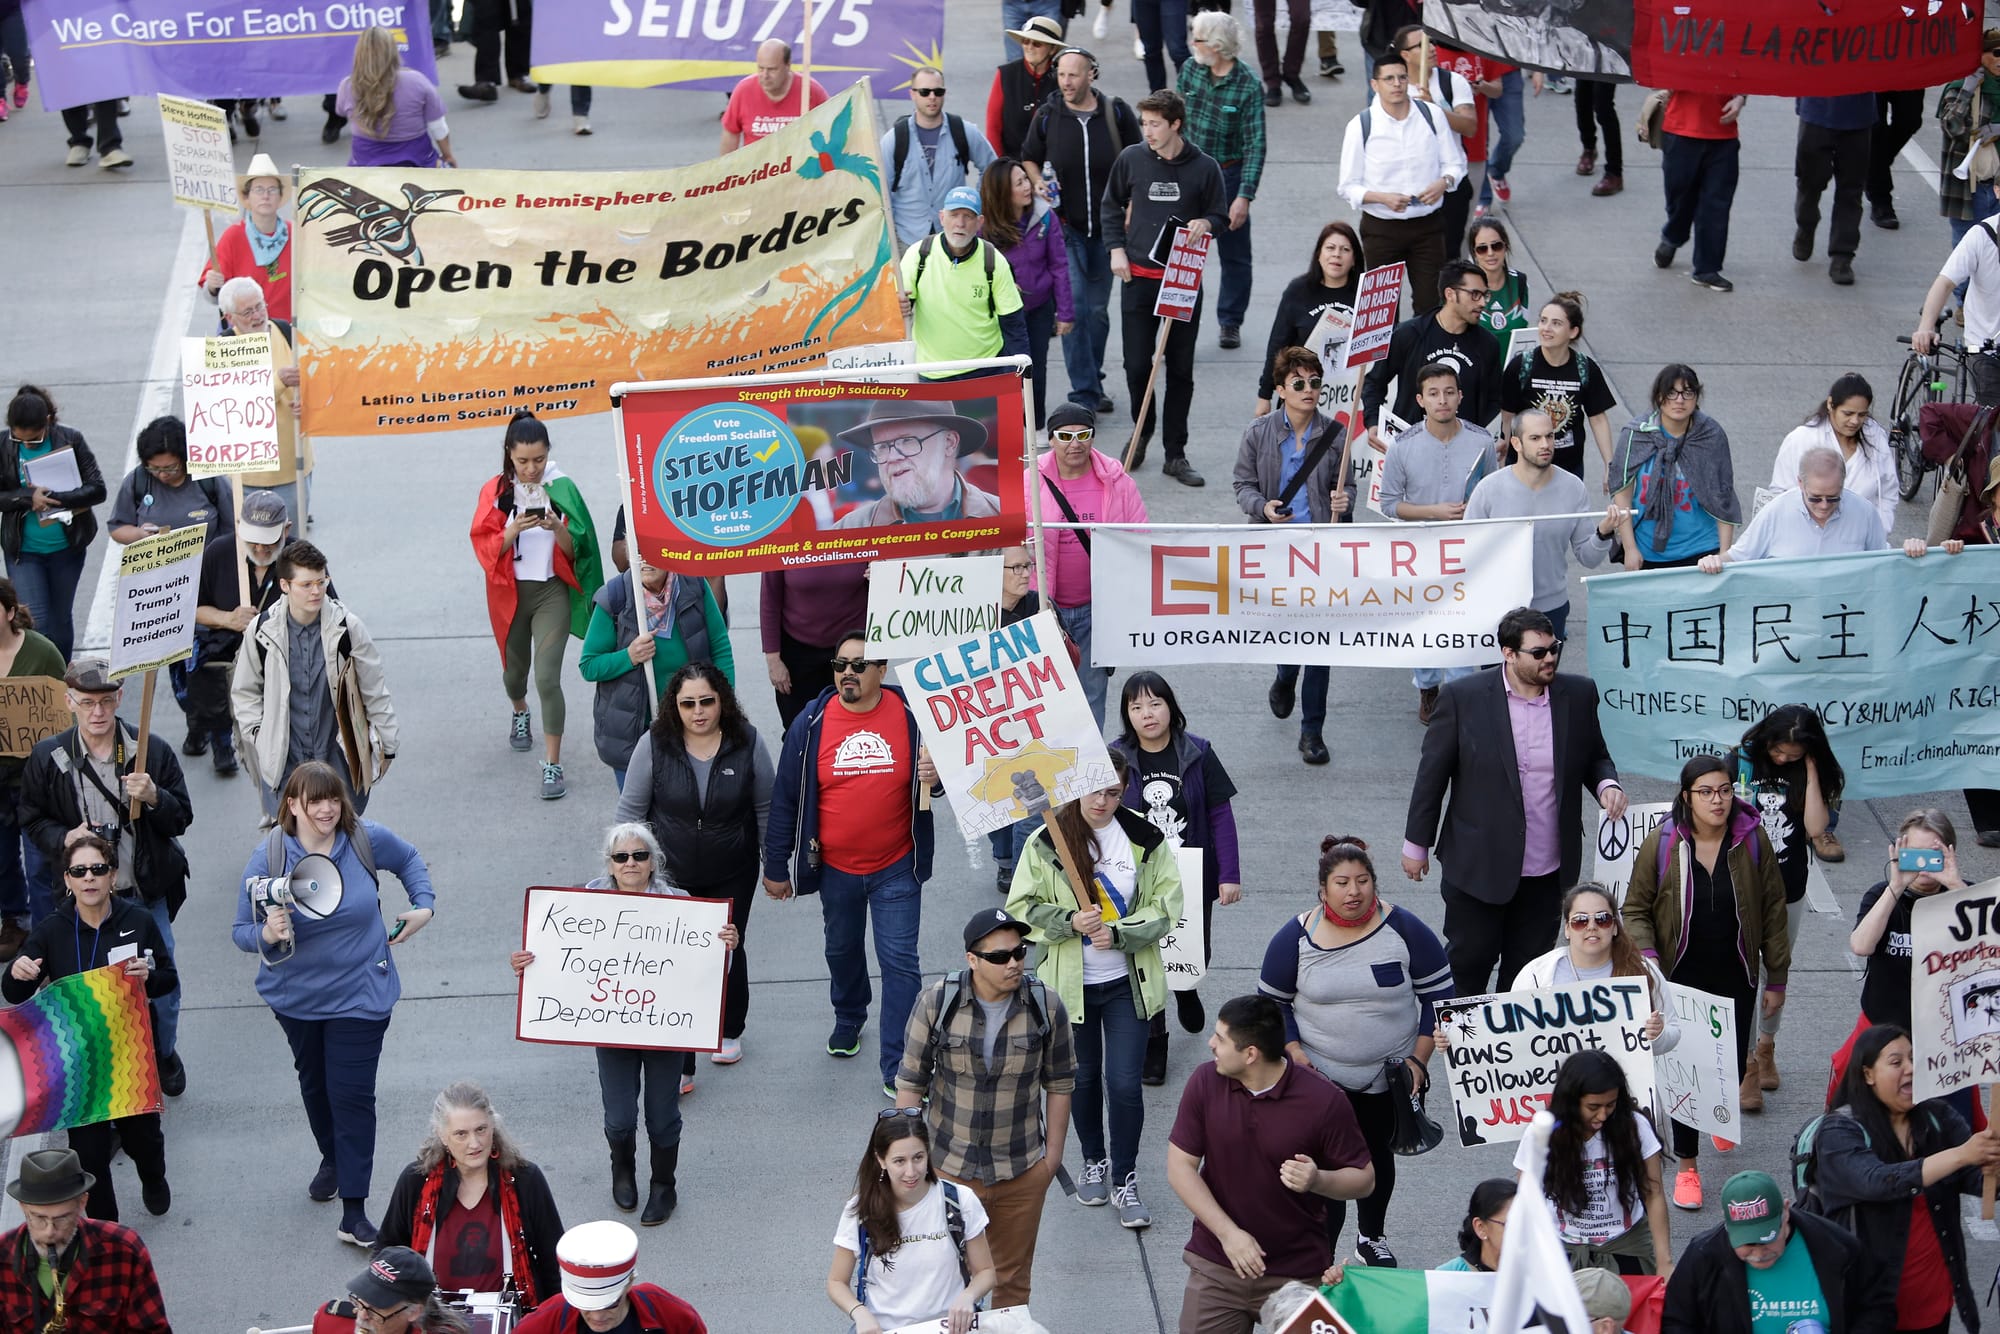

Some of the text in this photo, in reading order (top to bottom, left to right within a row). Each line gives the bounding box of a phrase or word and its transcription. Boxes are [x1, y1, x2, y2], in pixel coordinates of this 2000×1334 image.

[51, 2, 406, 42] We Care For Each Other
[603, 0, 873, 47] SEIU 775
[1660, 16, 1957, 66] VIVA LA REVOLUTION
[182, 126, 222, 147] STOP
[174, 175, 238, 205] FAMILIES
[458, 155, 793, 212] One hemisphere, undivided
[353, 198, 866, 309] Open the Borders
[1171, 250, 1205, 270] NO RAIDS
[1166, 267, 1197, 287] NO WAR
[1362, 269, 1400, 292] NO WALL
[1358, 293, 1370, 311] NO
[1371, 288, 1399, 308] RAIDS
[1354, 308, 1389, 332] NO WAR
[220, 345, 269, 358] Hoffman
[706, 335, 822, 369] Radical Women
[1350, 330, 1392, 352] RESIST TRUMP
[231, 359, 260, 368] Senate
[762, 351, 827, 373] Ixmucan
[183, 369, 272, 387] SOLIDARITY
[362, 378, 597, 407] Latino Liberation Movement
[738, 384, 910, 402] Strength through solidarity
[189, 396, 275, 434] ACROSS
[377, 398, 579, 427] Freedom Socialist Party
[713, 418, 741, 429] Vote
[678, 429, 777, 444] Freedom Socialist
[188, 440, 279, 463] BORDERS
[664, 443, 752, 482] STEVE
[671, 450, 855, 519] HOFFMAN
[710, 510, 753, 522] for U.S.
[713, 524, 751, 535] Senate
[1082, 512, 1095, 521] BE
[121, 535, 204, 567] Steve Hoffman
[128, 527, 200, 551] Freedom Socialist Party
[660, 525, 1001, 562] Send a union militant & antiwar veteran to Congress
[132, 552, 191, 574] For U.S. Senate
[781, 548, 879, 567] VoteSocialism.com
[1239, 538, 1466, 579] ENTRE
[128, 574, 190, 600] Down with
[899, 562, 964, 596] ¡Viva
[134, 592, 181, 612] Trump's
[1239, 581, 1466, 608] HERMANOS
[131, 609, 180, 632] Imperial
[865, 612, 882, 643] la
[122, 623, 184, 648] Presidency
[1129, 630, 1496, 649] TU ORGANIZACION LATINA LGBTQ
[914, 619, 1041, 692] CLEAN
[926, 655, 1066, 732] DREAM
[1604, 688, 1707, 716] CHINESE
[962, 703, 1046, 766] ACT
[542, 903, 712, 948] Keep Families
[561, 947, 674, 985] Together
[590, 978, 656, 1012] Stop
[529, 996, 693, 1029] Deportation
[1483, 985, 1641, 1034] UNJUST
[1447, 1026, 1651, 1070] laws can't be
[1927, 1042, 1993, 1071] NO MORE
[1455, 1060, 1561, 1098] followed
